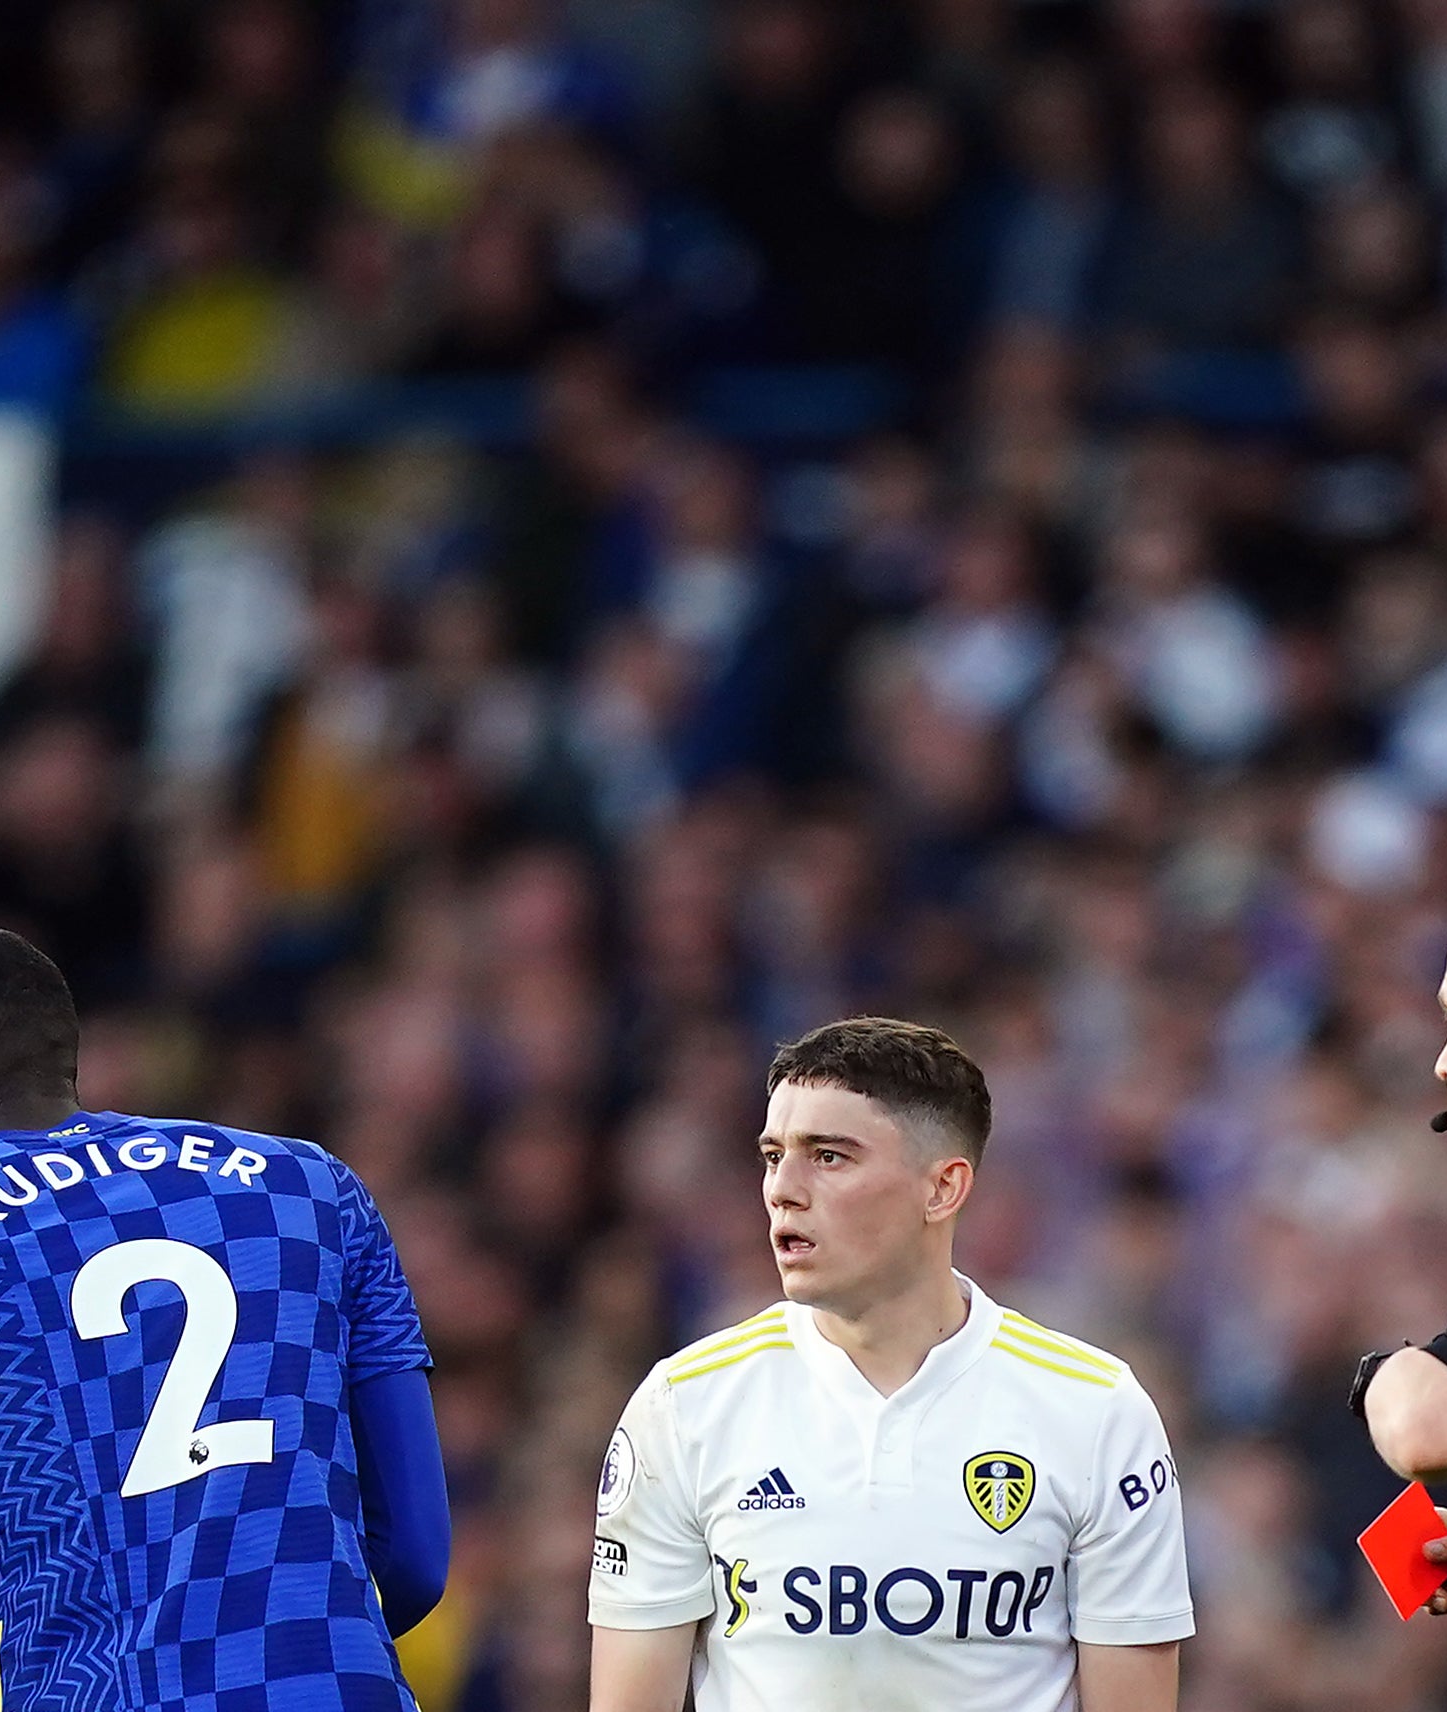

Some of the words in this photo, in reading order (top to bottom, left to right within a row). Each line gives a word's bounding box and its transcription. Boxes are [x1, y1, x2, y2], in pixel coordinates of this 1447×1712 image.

[69, 1237, 275, 1499] 2
[737, 1493, 806, 1512] adidas
[783, 1565, 1055, 1639] SBOTOP
